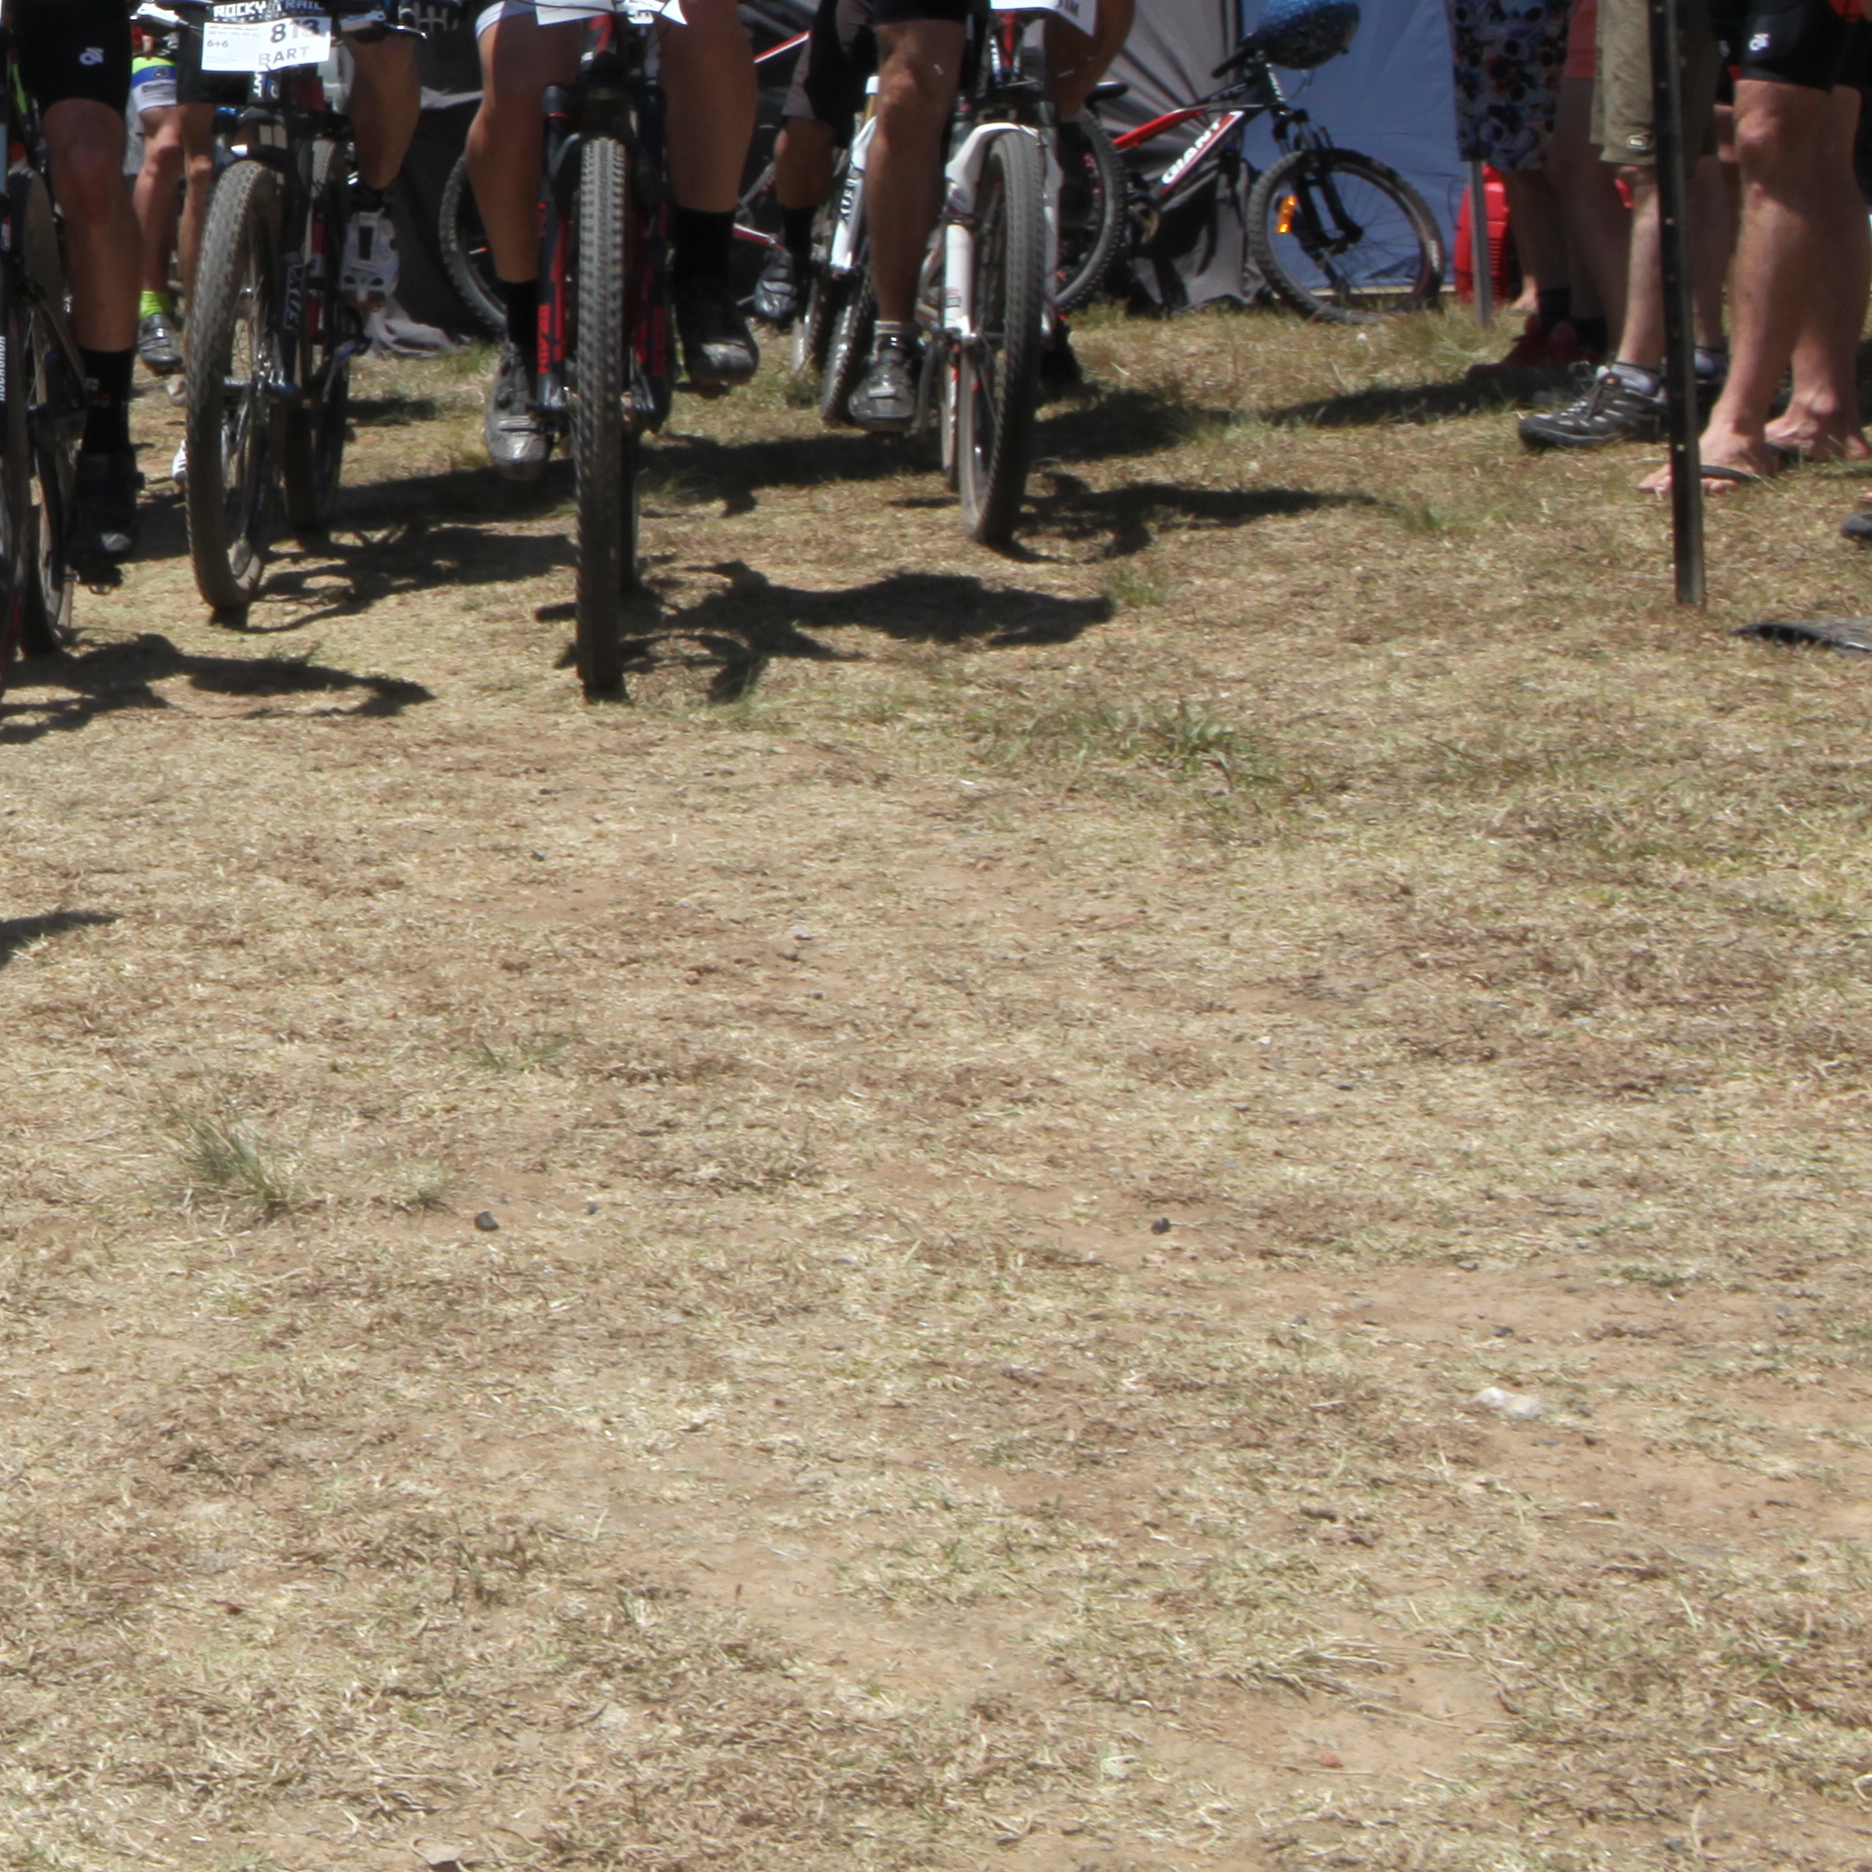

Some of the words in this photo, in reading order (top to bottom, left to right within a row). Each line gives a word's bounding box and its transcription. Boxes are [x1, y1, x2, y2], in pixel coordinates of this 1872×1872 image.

[213, 0, 267, 18] ROCKY
[258, 45, 310, 66] BART
[1160, 116, 1222, 185] GIANT
